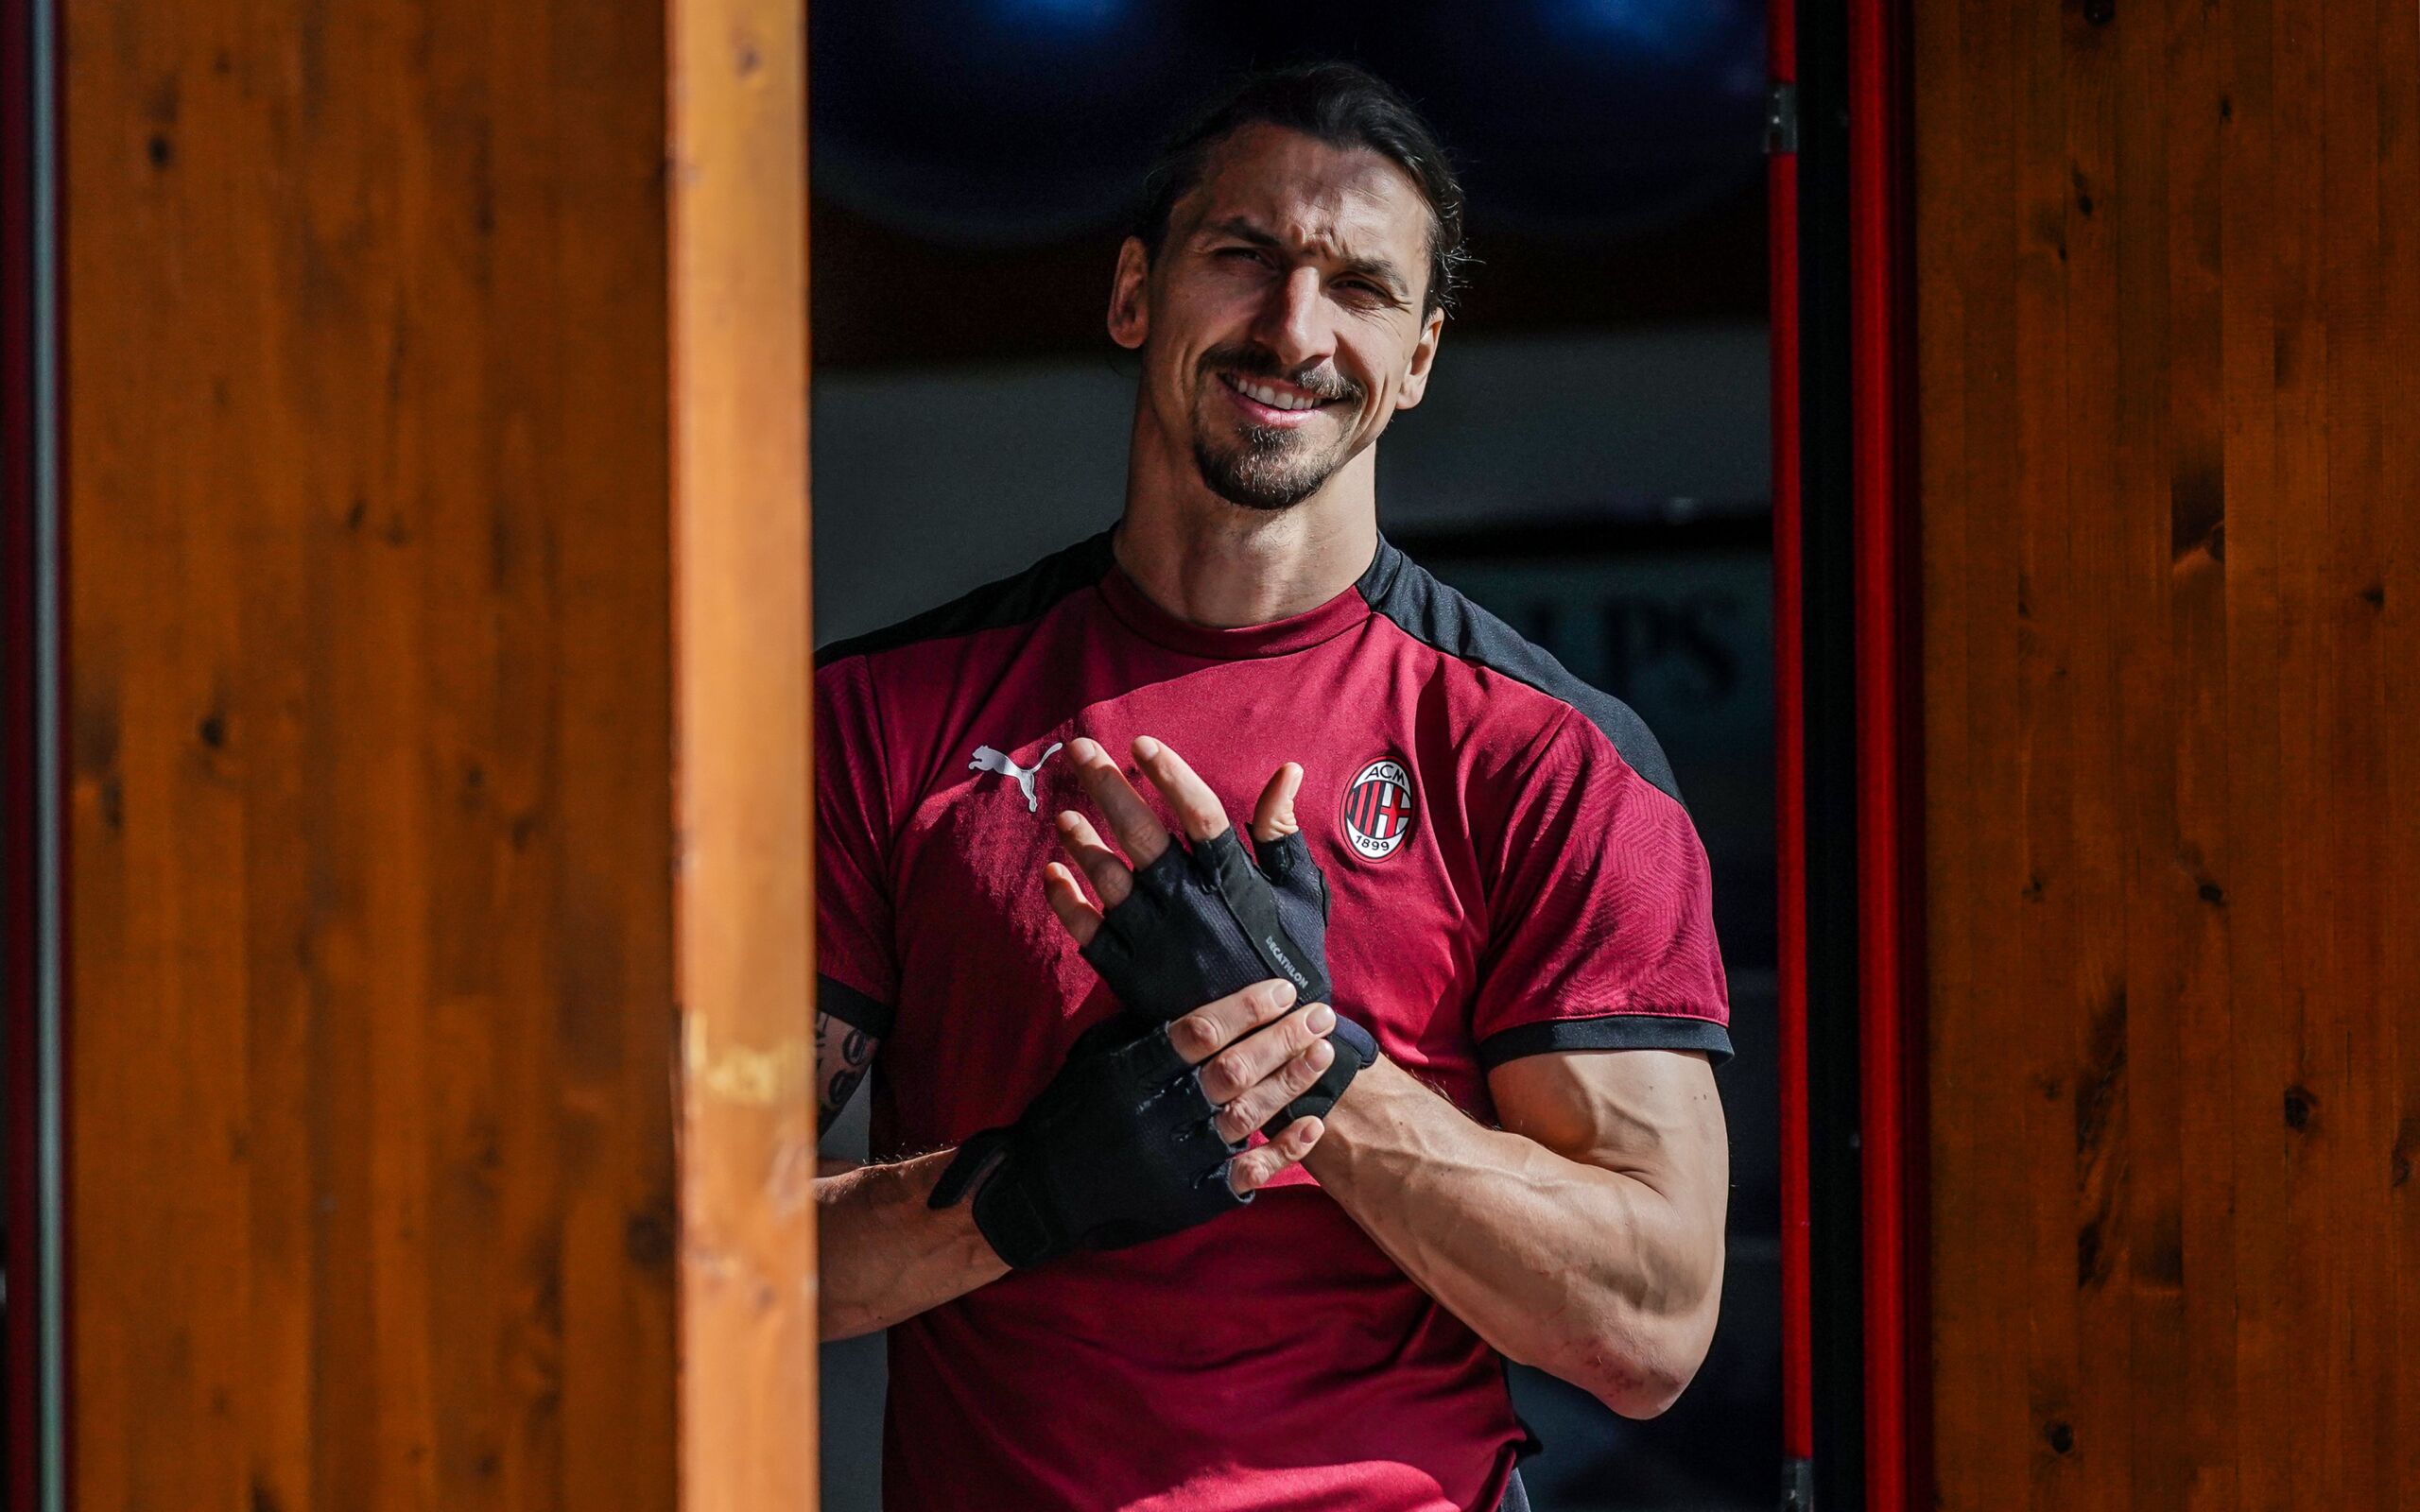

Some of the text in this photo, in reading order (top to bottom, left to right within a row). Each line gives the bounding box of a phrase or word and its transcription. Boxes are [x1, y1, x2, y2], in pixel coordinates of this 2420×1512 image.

[1364, 764, 1406, 786] ACM
[1356, 834, 1391, 851] 1899
[1265, 936, 1309, 989] DECATHLON
